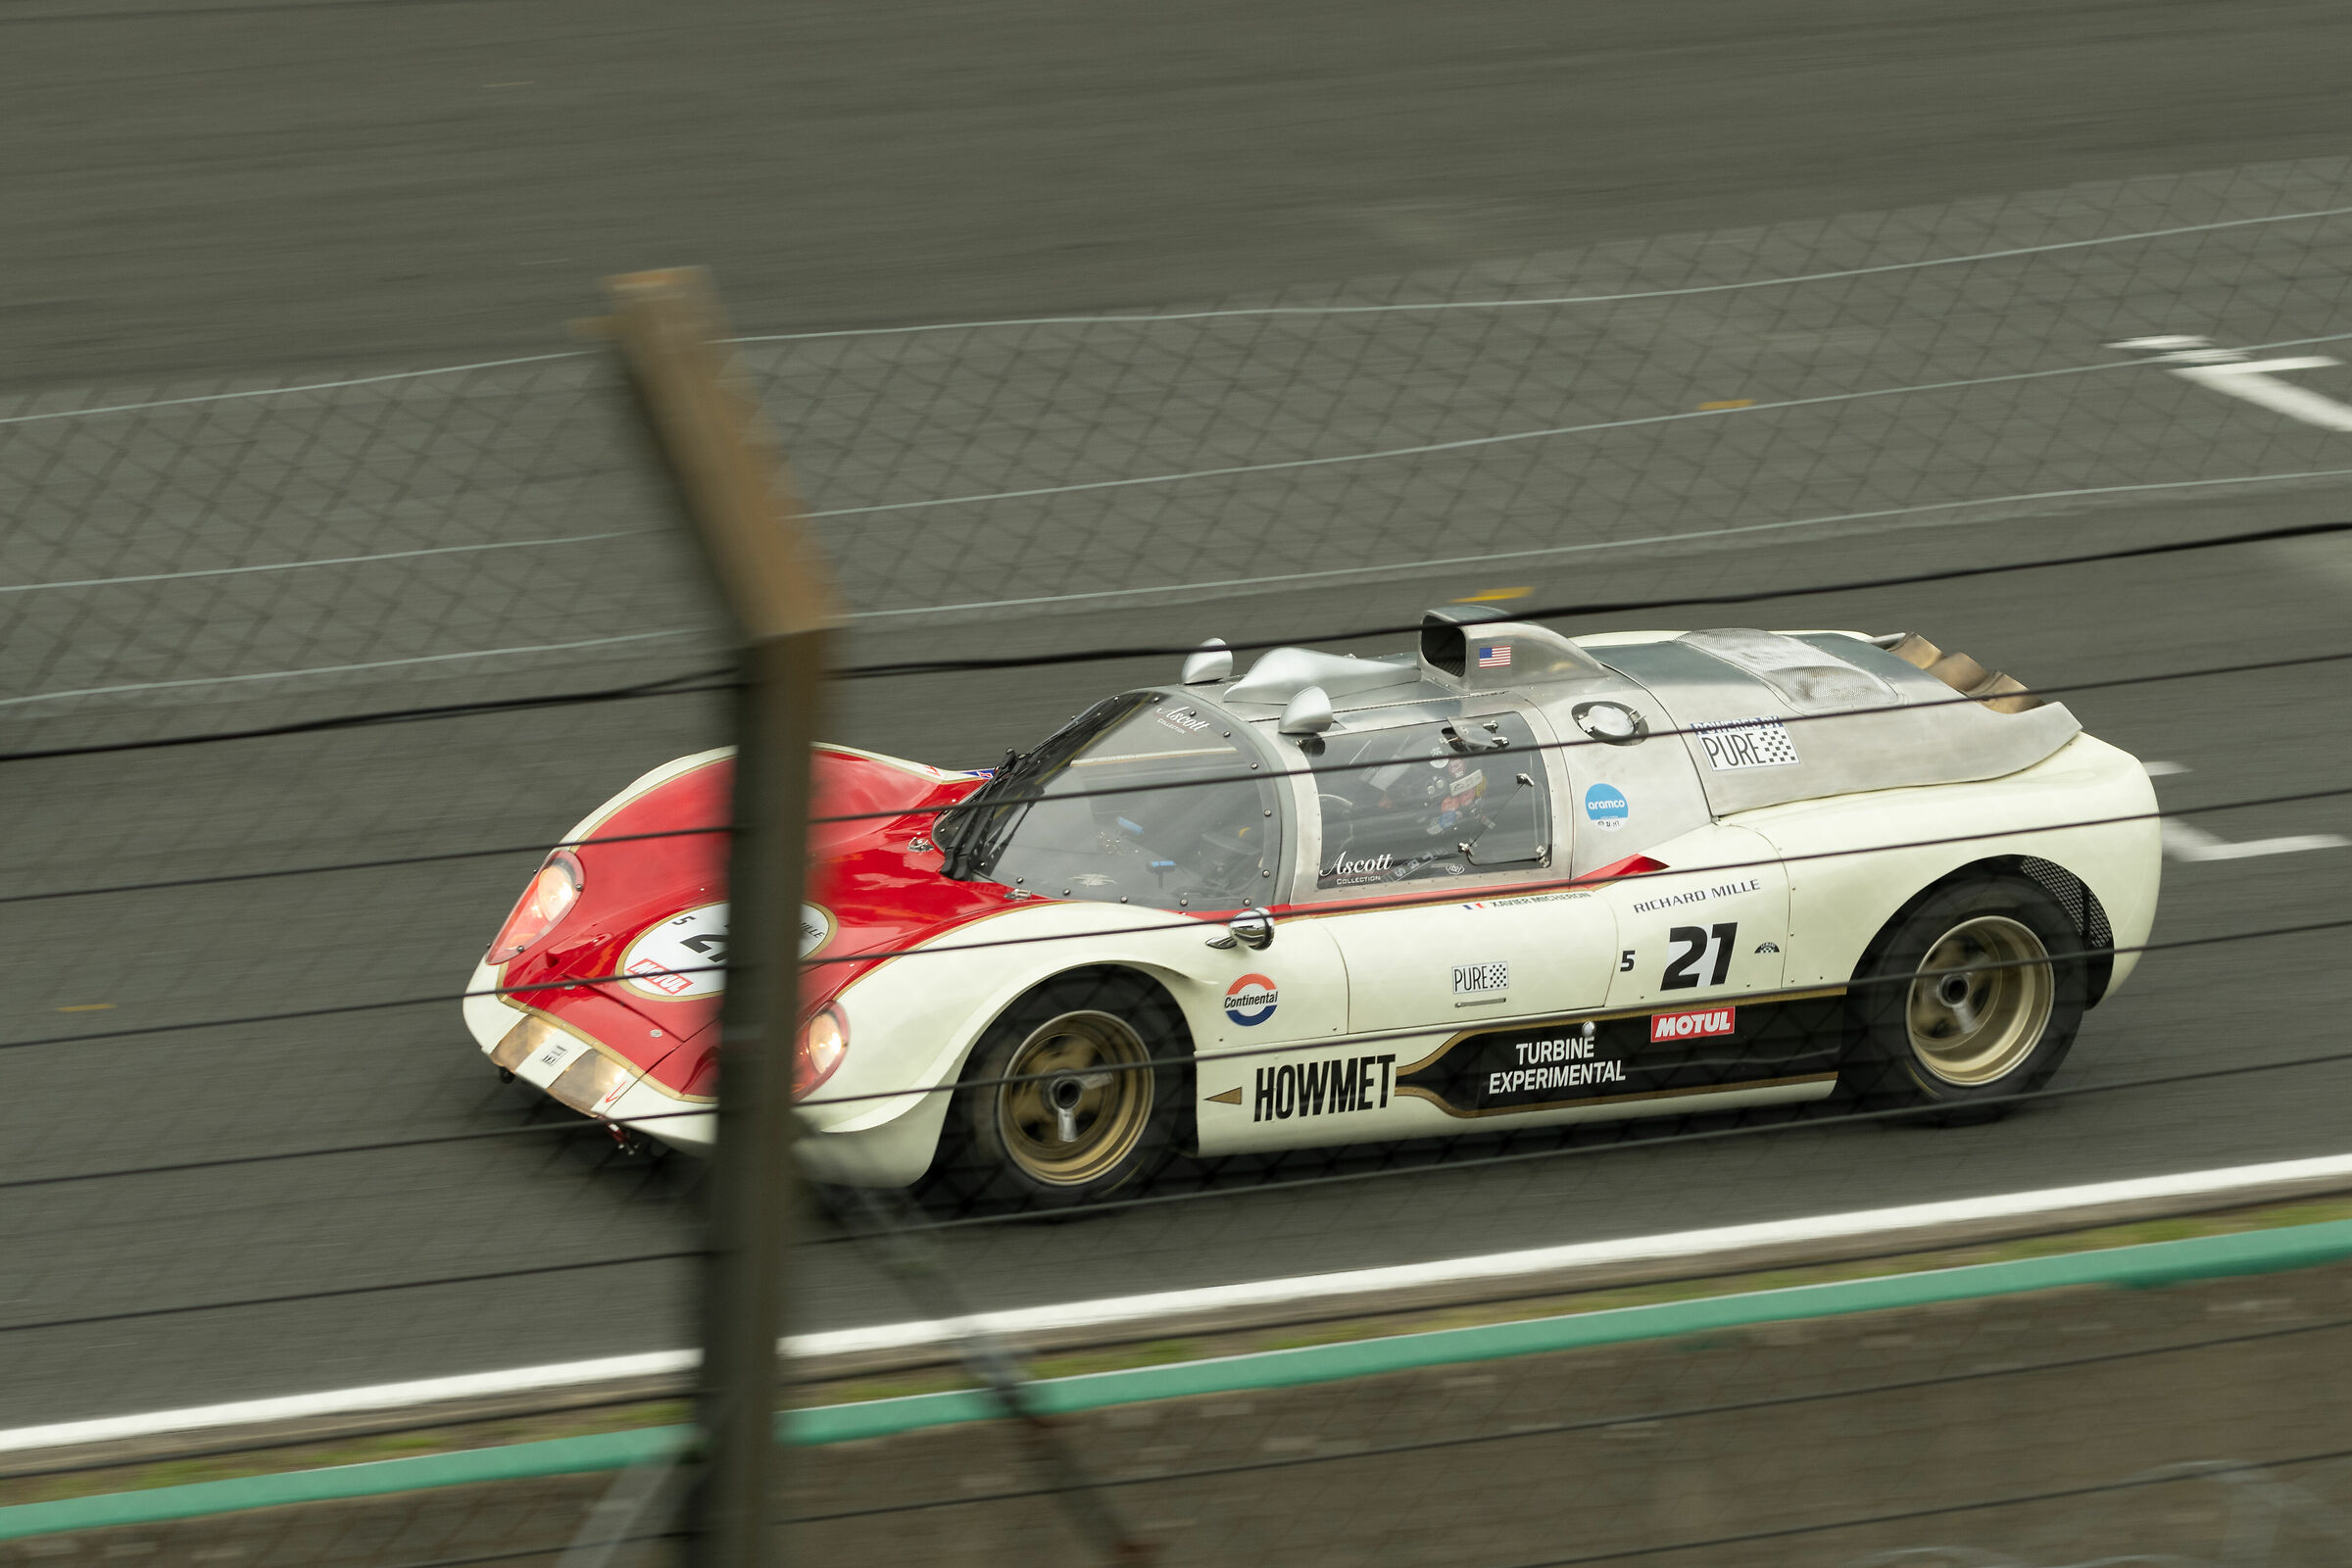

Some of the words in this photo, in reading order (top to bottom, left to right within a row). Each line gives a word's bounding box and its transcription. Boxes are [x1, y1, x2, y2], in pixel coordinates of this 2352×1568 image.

[1156, 706, 1210, 731] Ascott
[1701, 733, 1766, 767] PURE
[1588, 800, 1625, 809] aramco
[1320, 851, 1394, 877] Ascott
[1337, 875, 1381, 885] COLLECTION
[1634, 890, 1706, 913] RICHARD
[1711, 879, 1761, 899] MILLE
[671, 915, 697, 926] 5
[1620, 951, 1636, 972] 5
[1660, 922, 1738, 992] 21
[1454, 965, 1489, 992] PURE
[1224, 991, 1278, 1008] Continental
[1655, 1011, 1731, 1039] MOTUL
[1516, 1037, 1594, 1066] TURBINE
[1253, 1054, 1396, 1123] HOWMET
[1489, 1060, 1627, 1095] EXPERIMENTAL
